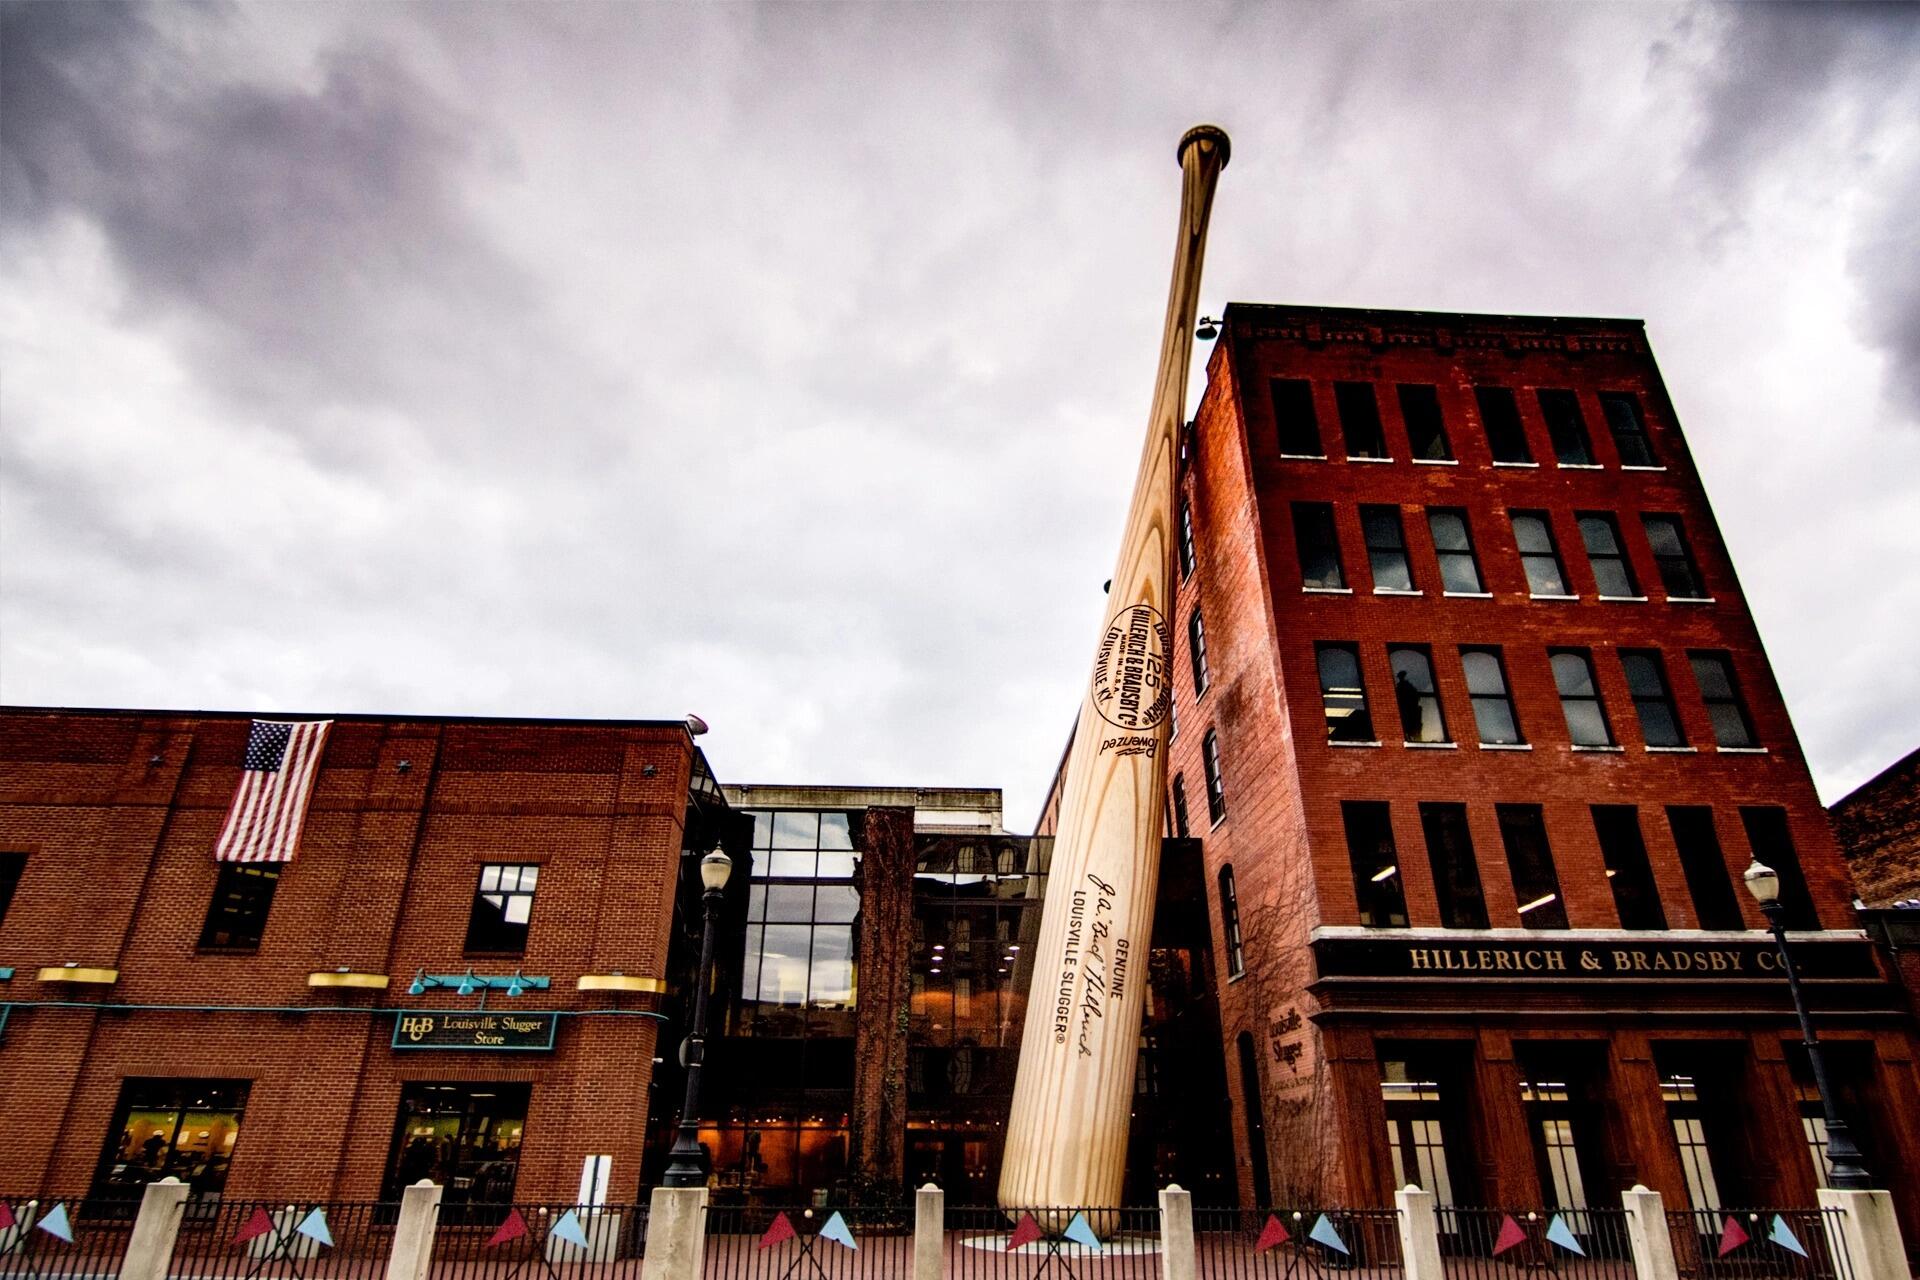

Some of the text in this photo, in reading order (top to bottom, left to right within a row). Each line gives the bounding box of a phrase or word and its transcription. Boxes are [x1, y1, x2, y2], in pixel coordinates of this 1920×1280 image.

[1118, 634, 1127, 654] MADE
[1127, 608, 1151, 656] HILLERICH
[1117, 658, 1124, 666] IN
[1125, 656, 1144, 665] &
[1145, 652, 1162, 689] 125
[1119, 665, 1143, 714] BRADSBY
[1064, 890, 1087, 966] LOUISVILLE
[1111, 938, 1130, 1001] GENUINE
[1410, 948, 1567, 971] HILLERICH
[1580, 950, 1602, 971] &
[1611, 950, 1742, 971] BRADSBY
[443, 1016, 497, 1030] Louisville
[501, 1016, 542, 1032] Slugger
[1078, 965, 1106, 1059] Hillerich
[474, 1031, 505, 1045] Store
